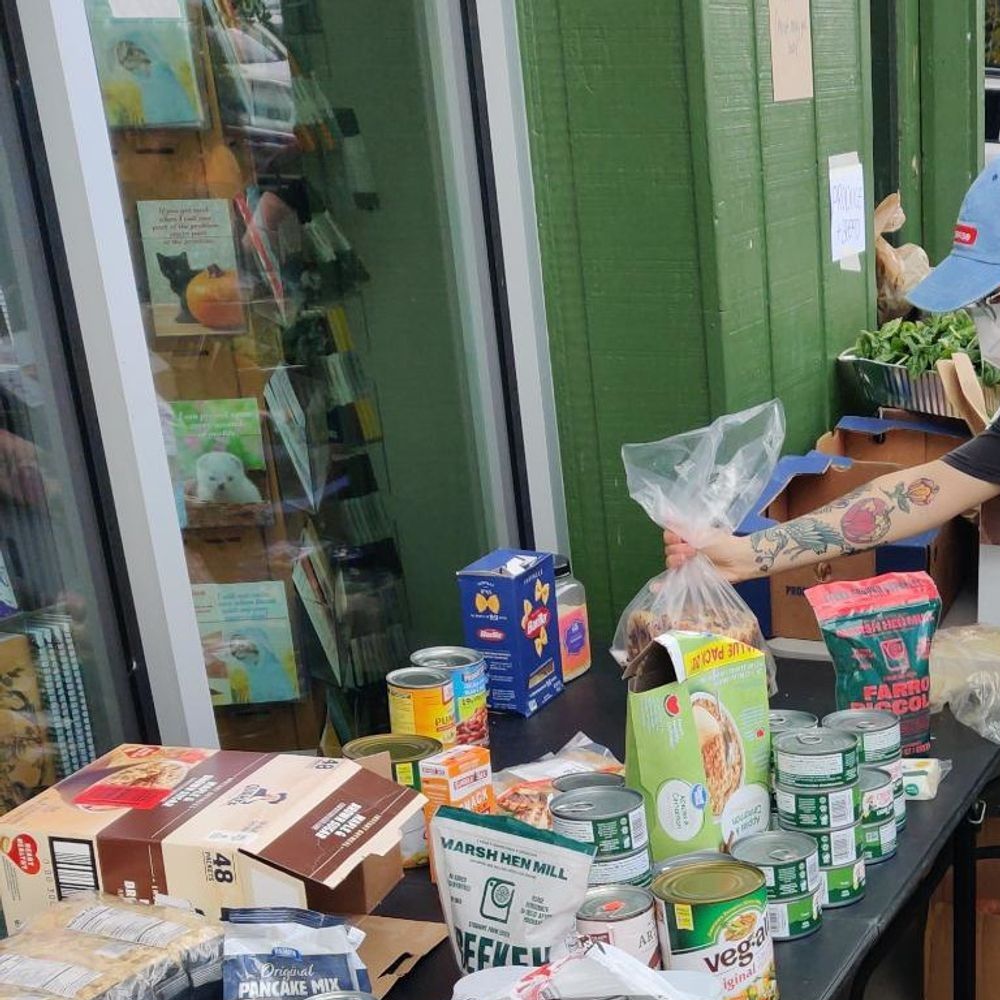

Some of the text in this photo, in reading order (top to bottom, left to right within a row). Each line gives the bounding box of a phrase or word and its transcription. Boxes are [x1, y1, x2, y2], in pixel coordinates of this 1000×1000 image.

[863, 678, 930, 700] FARRO
[213, 852, 234, 884] 48
[440, 837, 568, 881] MARSH HEN MILL
[261, 963, 315, 980] Original
[238, 978, 341, 998] PANCAKE MIX
